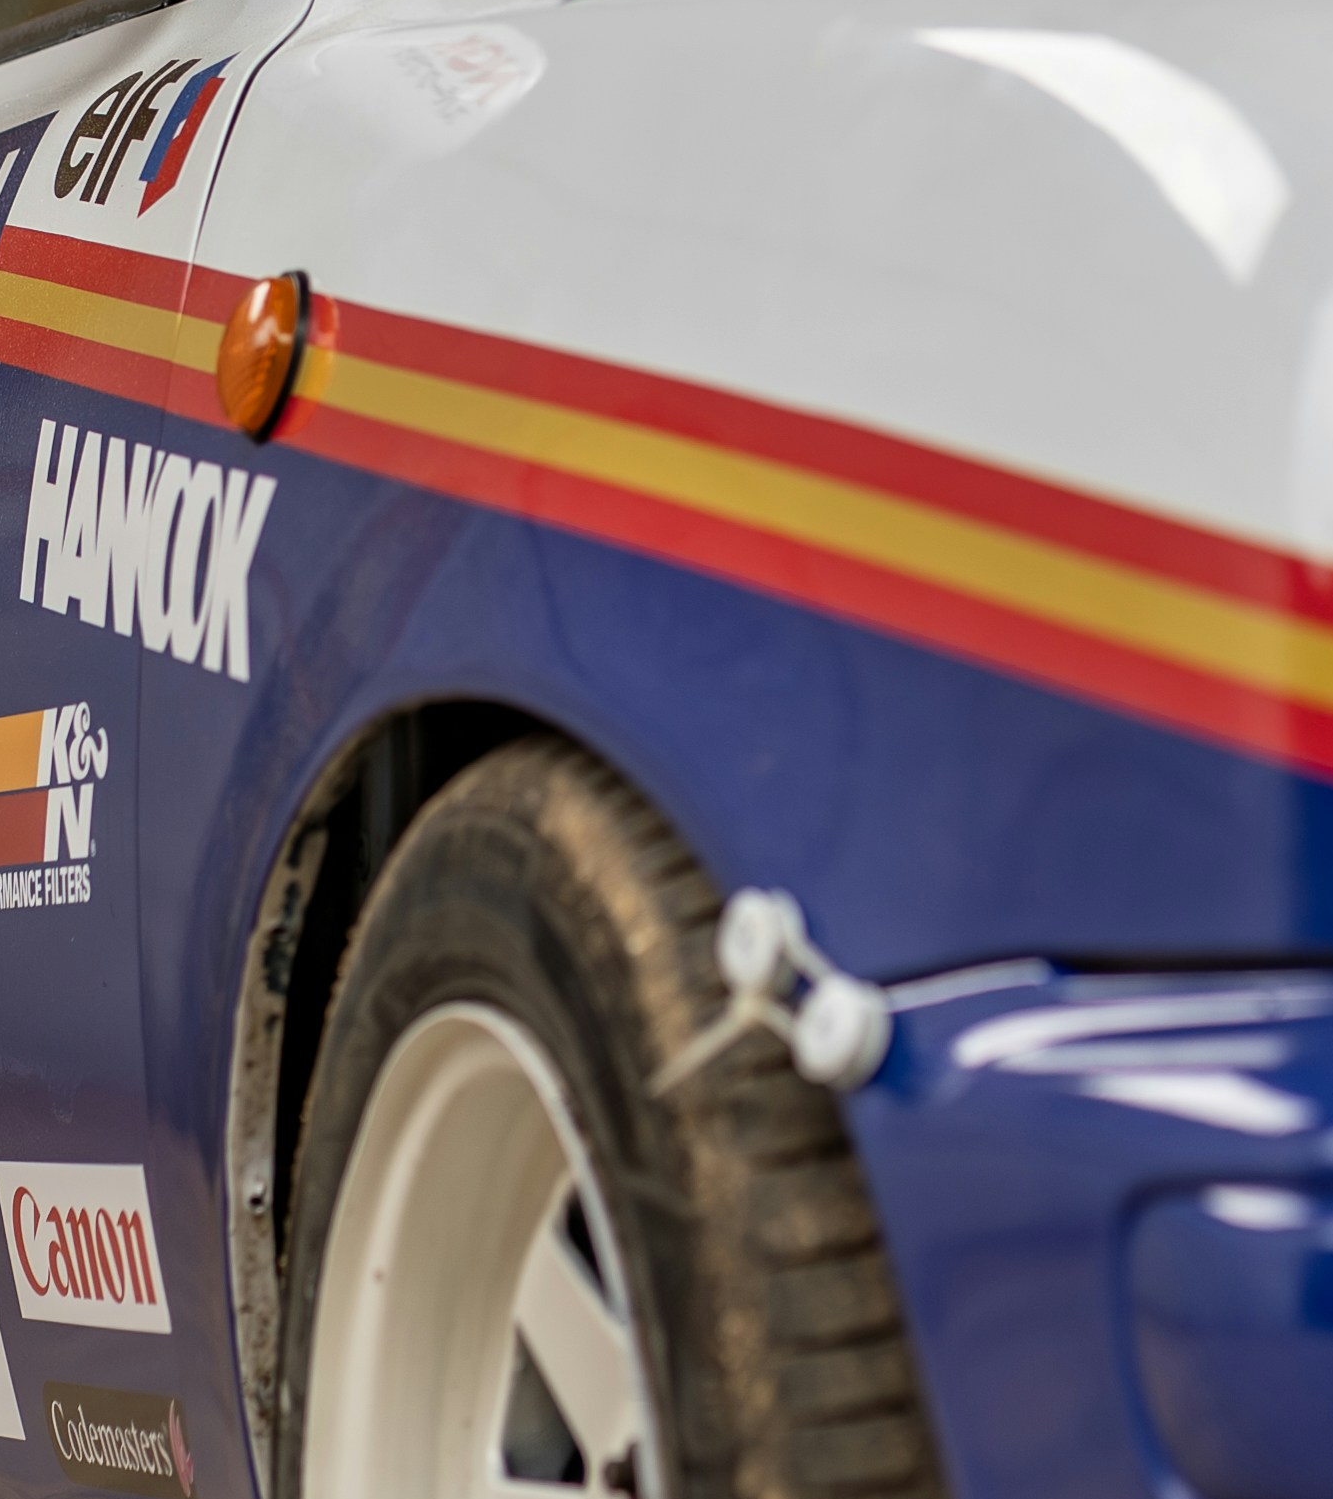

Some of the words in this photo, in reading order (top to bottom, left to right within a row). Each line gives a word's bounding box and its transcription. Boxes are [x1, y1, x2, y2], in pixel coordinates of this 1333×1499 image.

[53, 57, 203, 206] elf
[44, 862, 91, 906] FILTERS
[11, 1185, 158, 1306] Canon
[51, 1399, 173, 1478] Codemasters
